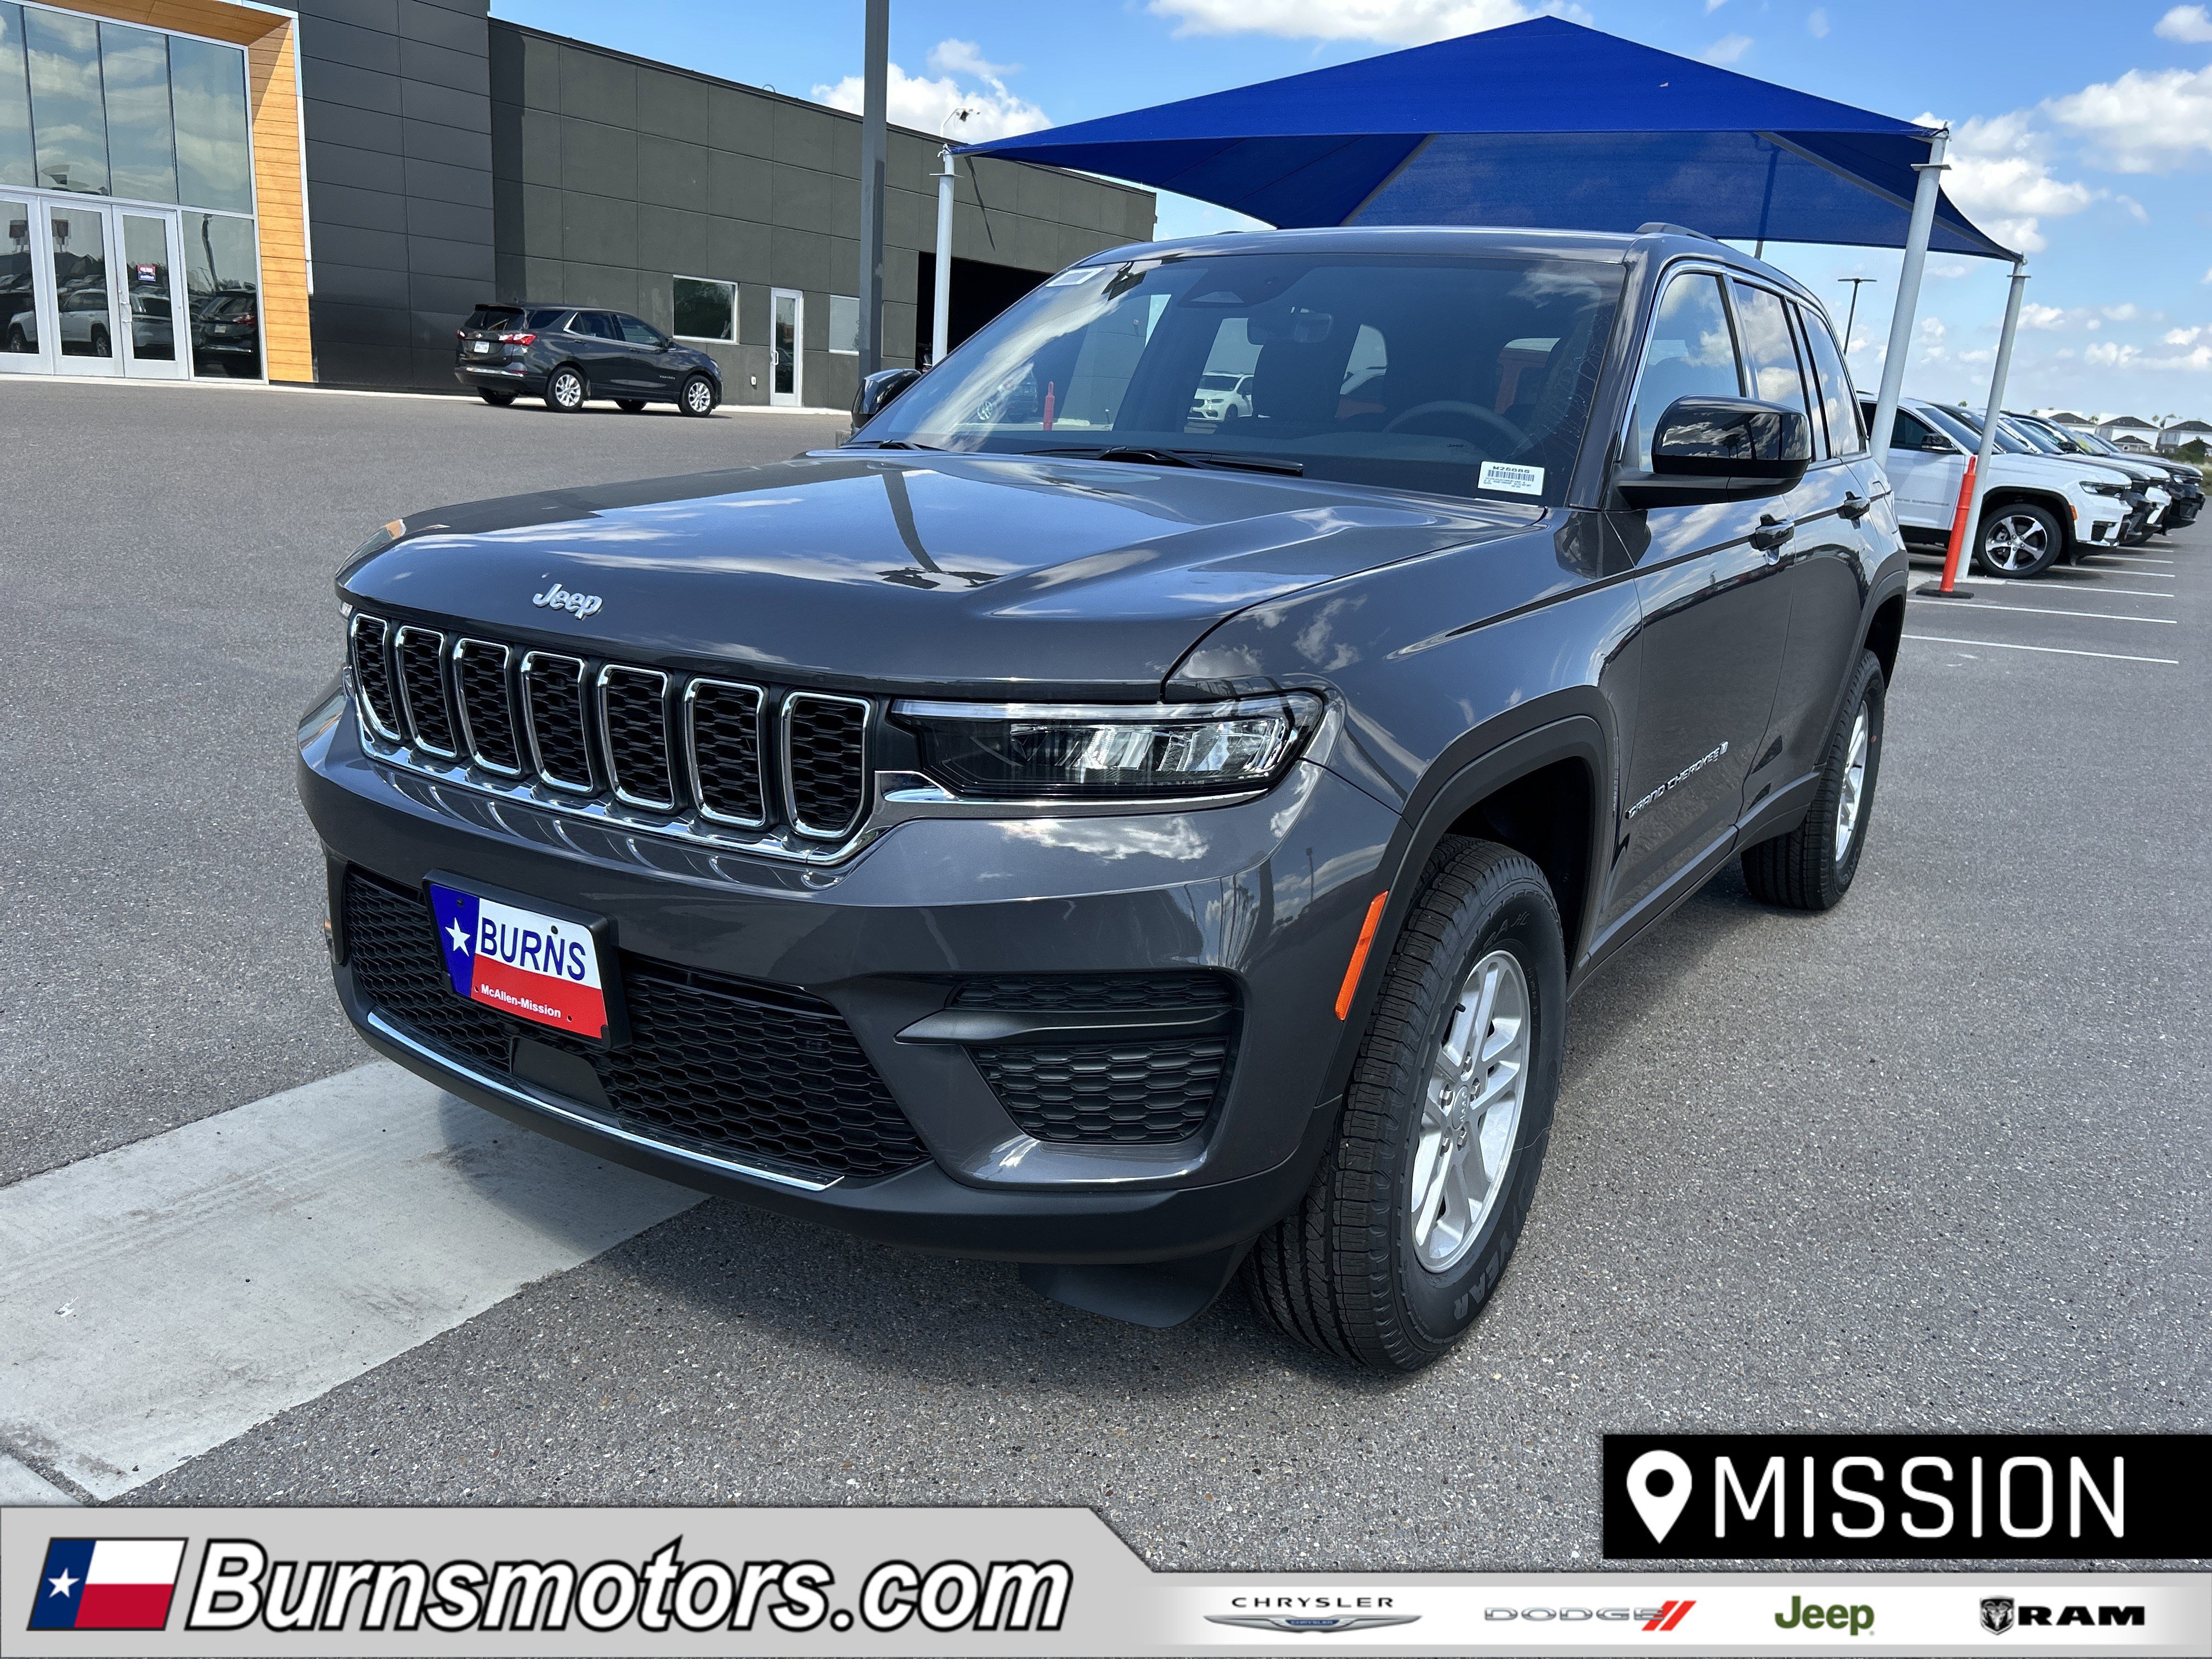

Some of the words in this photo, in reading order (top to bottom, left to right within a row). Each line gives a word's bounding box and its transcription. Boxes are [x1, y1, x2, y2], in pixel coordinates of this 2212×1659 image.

[533, 583, 603, 620] Jeep
[1626, 785, 1666, 820] GRAND
[1666, 747, 1720, 791] CHEROKEE
[481, 917, 586, 981] BURNS
[481, 984, 562, 1019] McAllen-Mission
